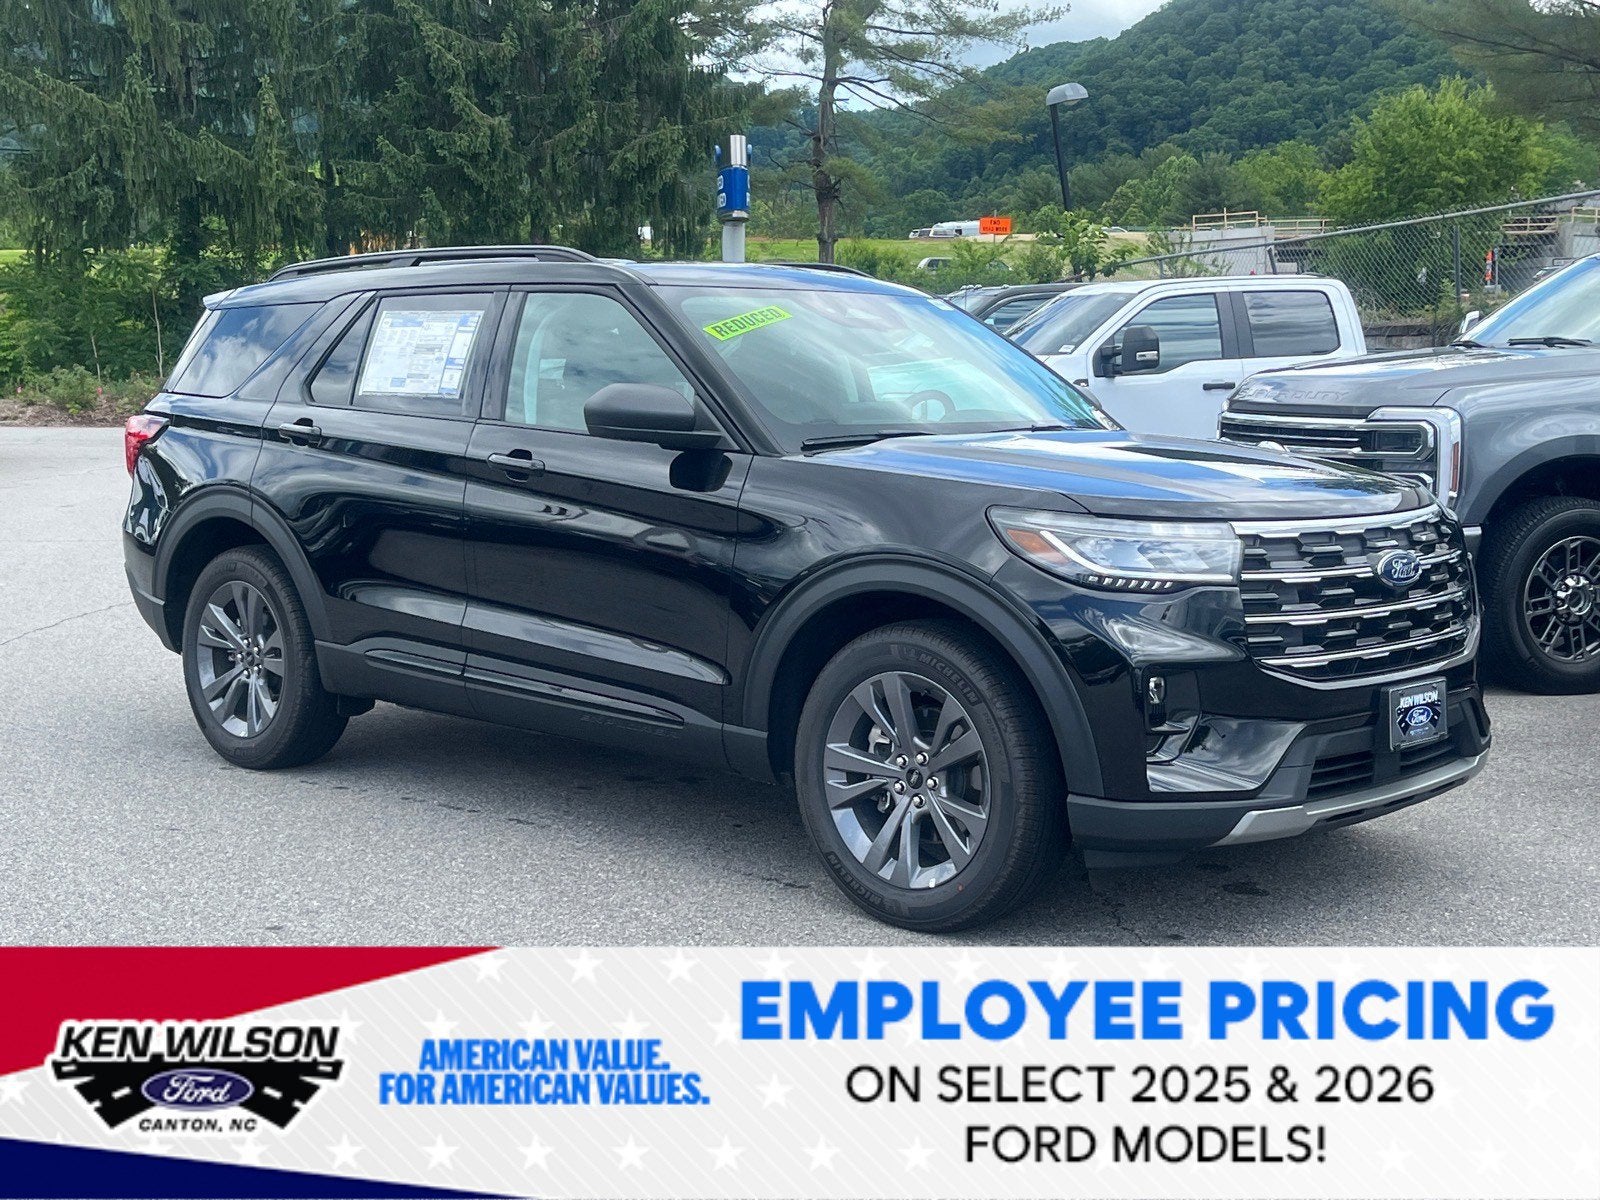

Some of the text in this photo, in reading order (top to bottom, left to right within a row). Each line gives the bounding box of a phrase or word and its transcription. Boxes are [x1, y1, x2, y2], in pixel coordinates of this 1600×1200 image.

[710, 307, 784, 337] REDUCED
[918, 652, 979, 704] MICHELIN
[1399, 690, 1438, 709] KEN WILSON
